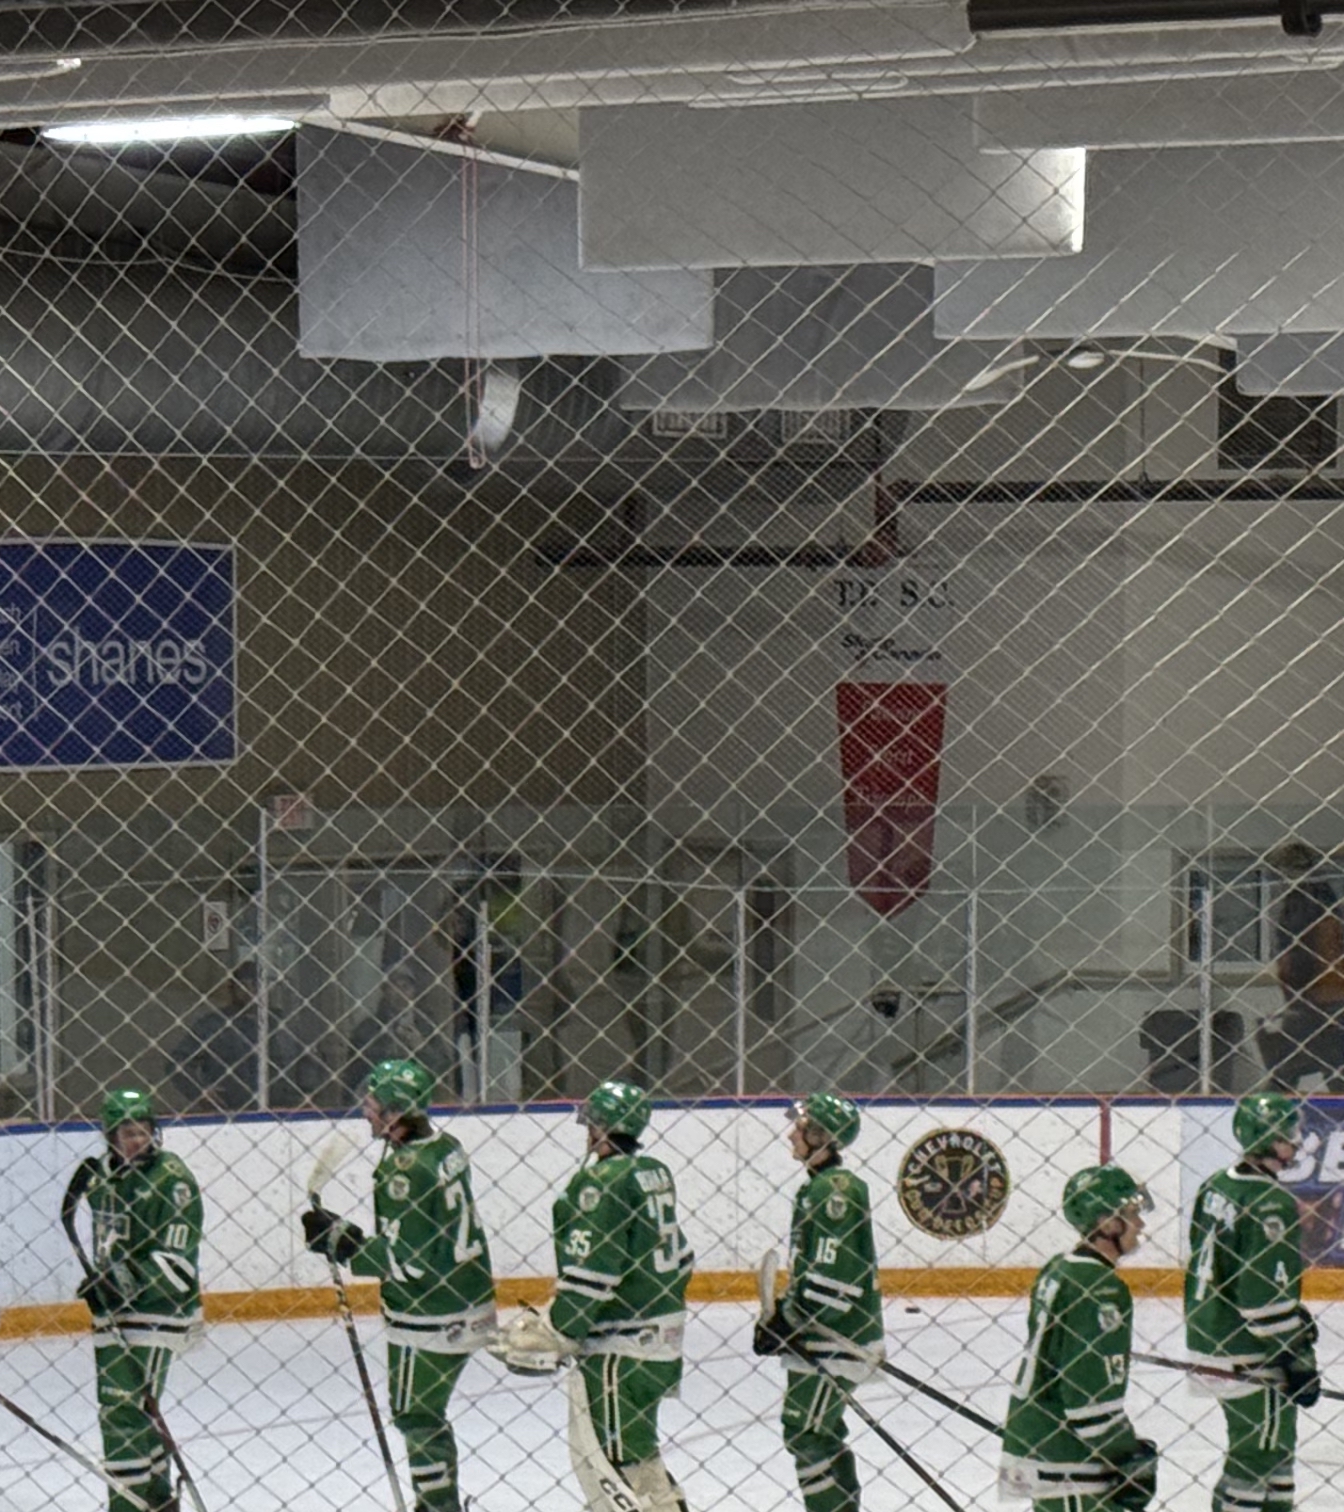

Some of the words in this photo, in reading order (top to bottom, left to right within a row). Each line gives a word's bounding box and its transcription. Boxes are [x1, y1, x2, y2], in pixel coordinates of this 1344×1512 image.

[46, 625, 208, 687] shanes
[164, 1223, 190, 1250] 10
[564, 1228, 593, 1259] 35
[816, 1236, 843, 1265] 16
